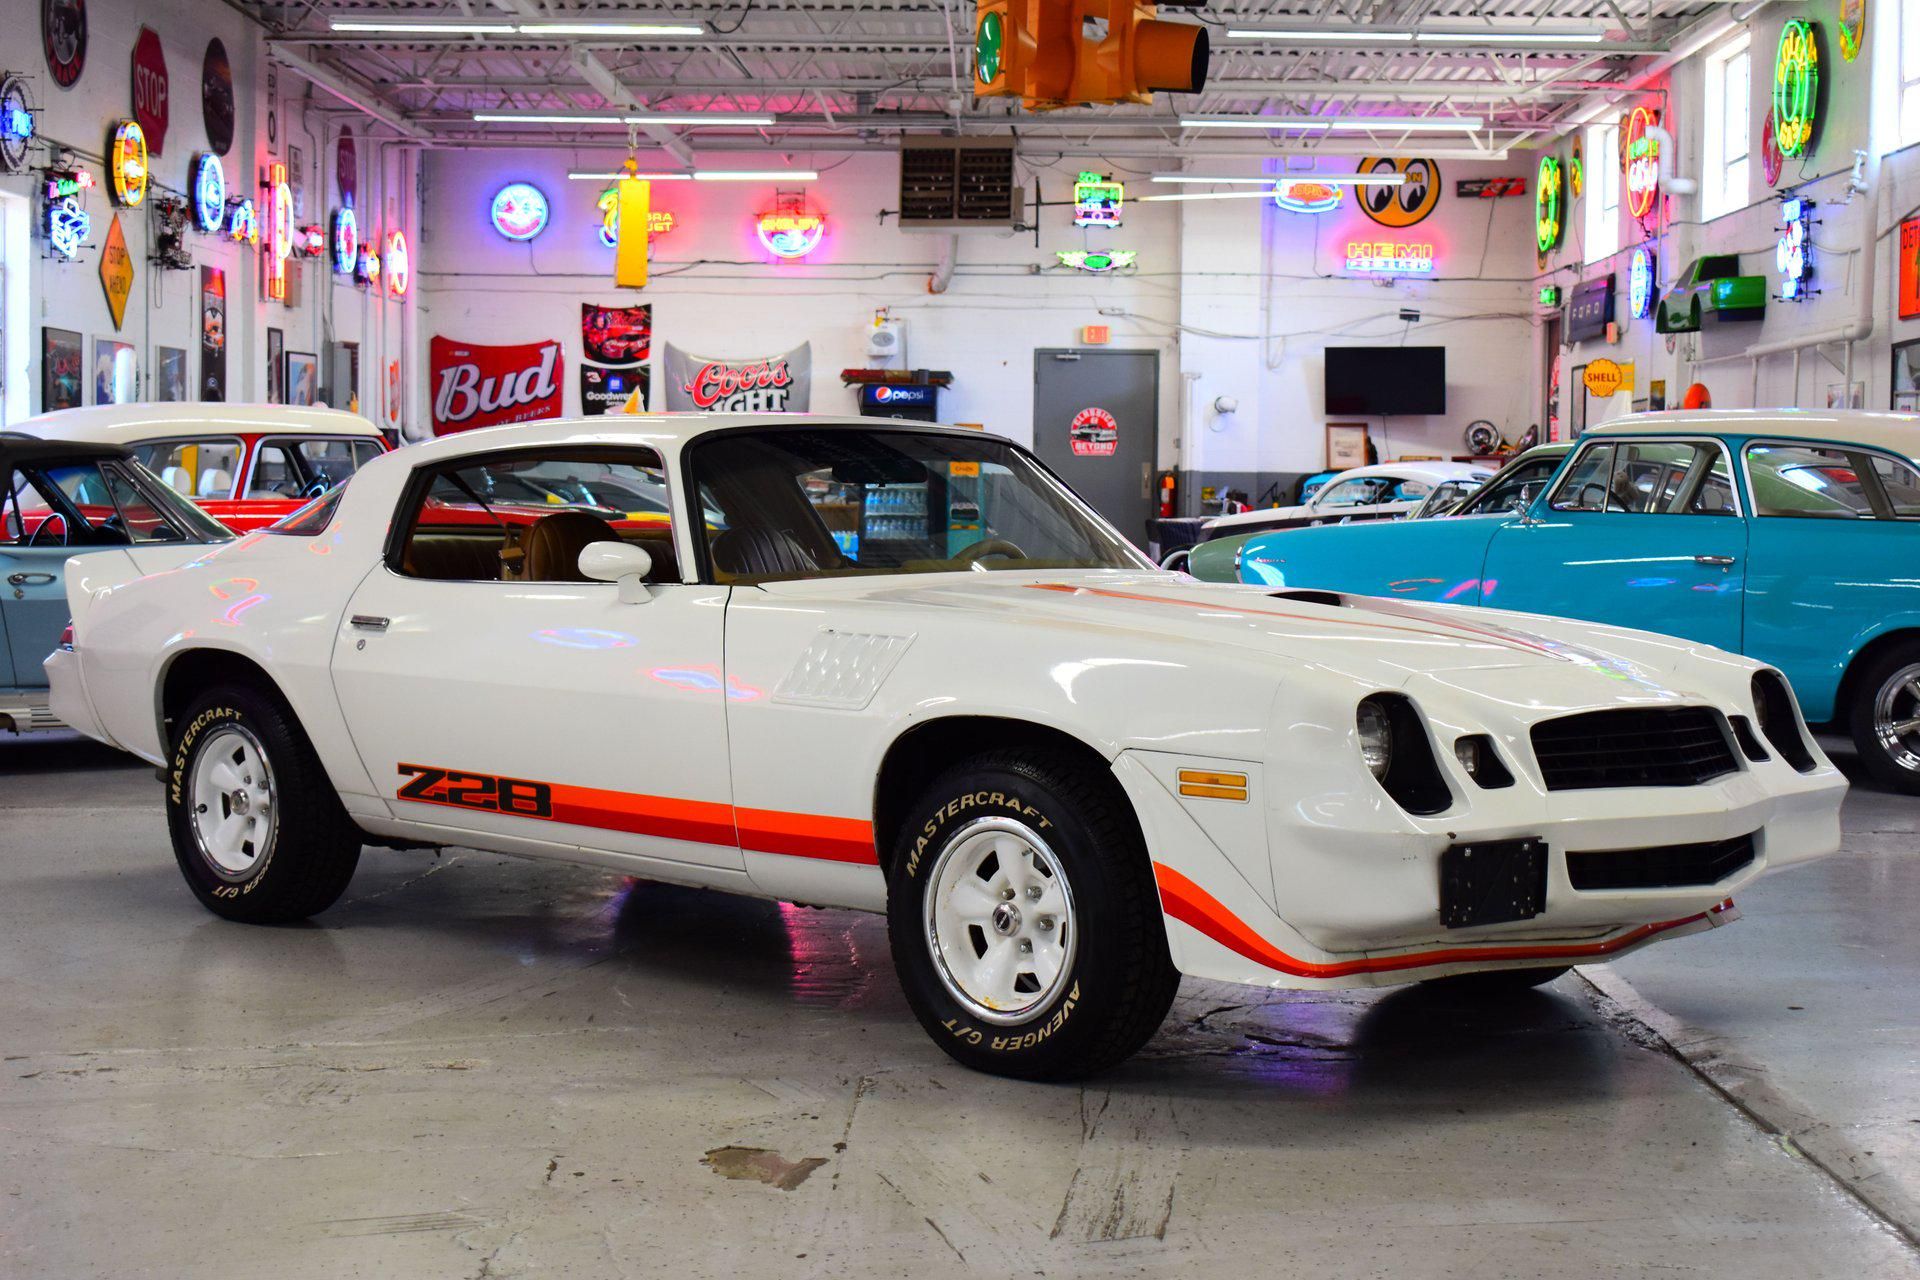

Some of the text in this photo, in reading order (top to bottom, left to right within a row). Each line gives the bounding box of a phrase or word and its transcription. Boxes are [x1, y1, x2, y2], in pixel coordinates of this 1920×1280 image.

[136, 64, 167, 119] STOP
[109, 245, 126, 265] STOP
[1348, 243, 1433, 259] HEMI
[109, 275, 127, 295] AHEAD
[1572, 302, 1600, 321] FORD
[1087, 327, 1109, 343] EXIT
[435, 345, 557, 423] Bud
[684, 359, 794, 408] Coors
[1587, 373, 1618, 383] SHELL
[892, 390, 925, 402] pepsi
[1075, 441, 1114, 451] BEYOND
[171, 706, 243, 805] MASTERCRAFT
[397, 763, 553, 819] Z28
[906, 790, 1054, 878] MASTERCRAFT
[211, 884, 239, 899] G/T
[941, 979, 1081, 1051] AVENGER G/T
